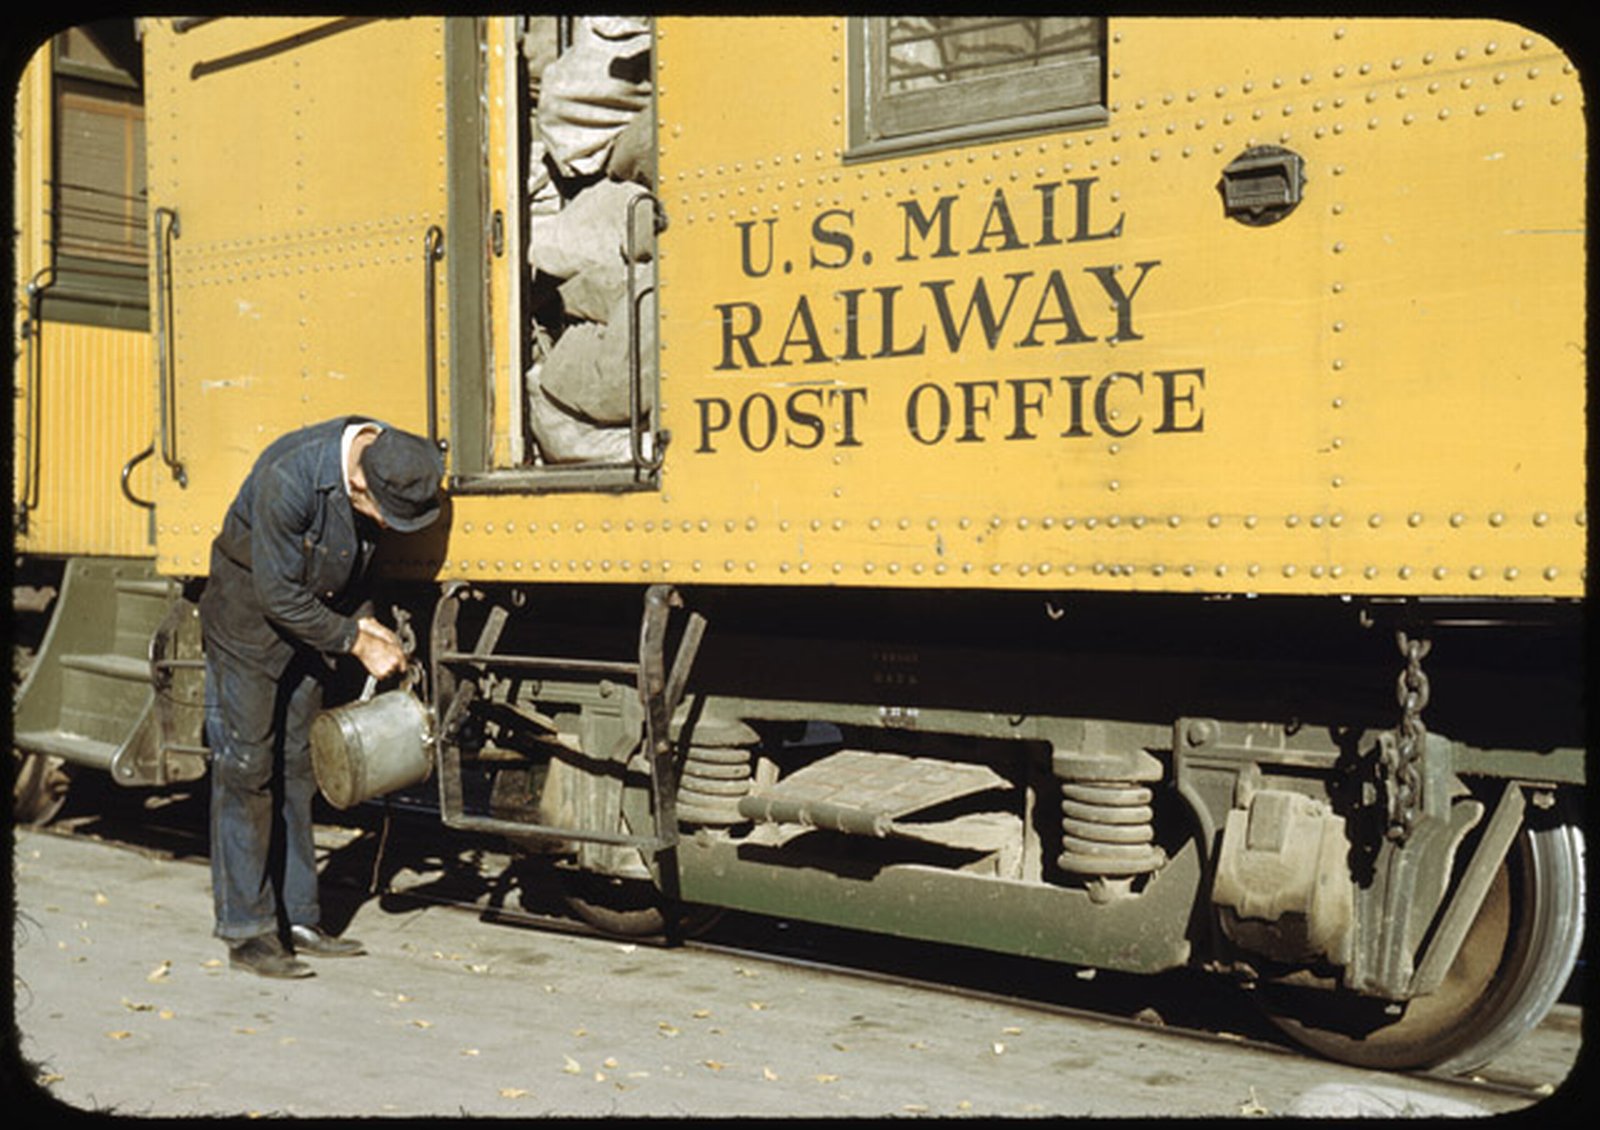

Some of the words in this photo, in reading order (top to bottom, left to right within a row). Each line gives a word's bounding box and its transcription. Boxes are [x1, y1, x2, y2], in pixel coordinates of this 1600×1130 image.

[895, 176, 1126, 262] MAIL
[713, 260, 1162, 371] RAILWAY
[694, 387, 868, 455] POST
[905, 368, 1206, 446] OFFICE
